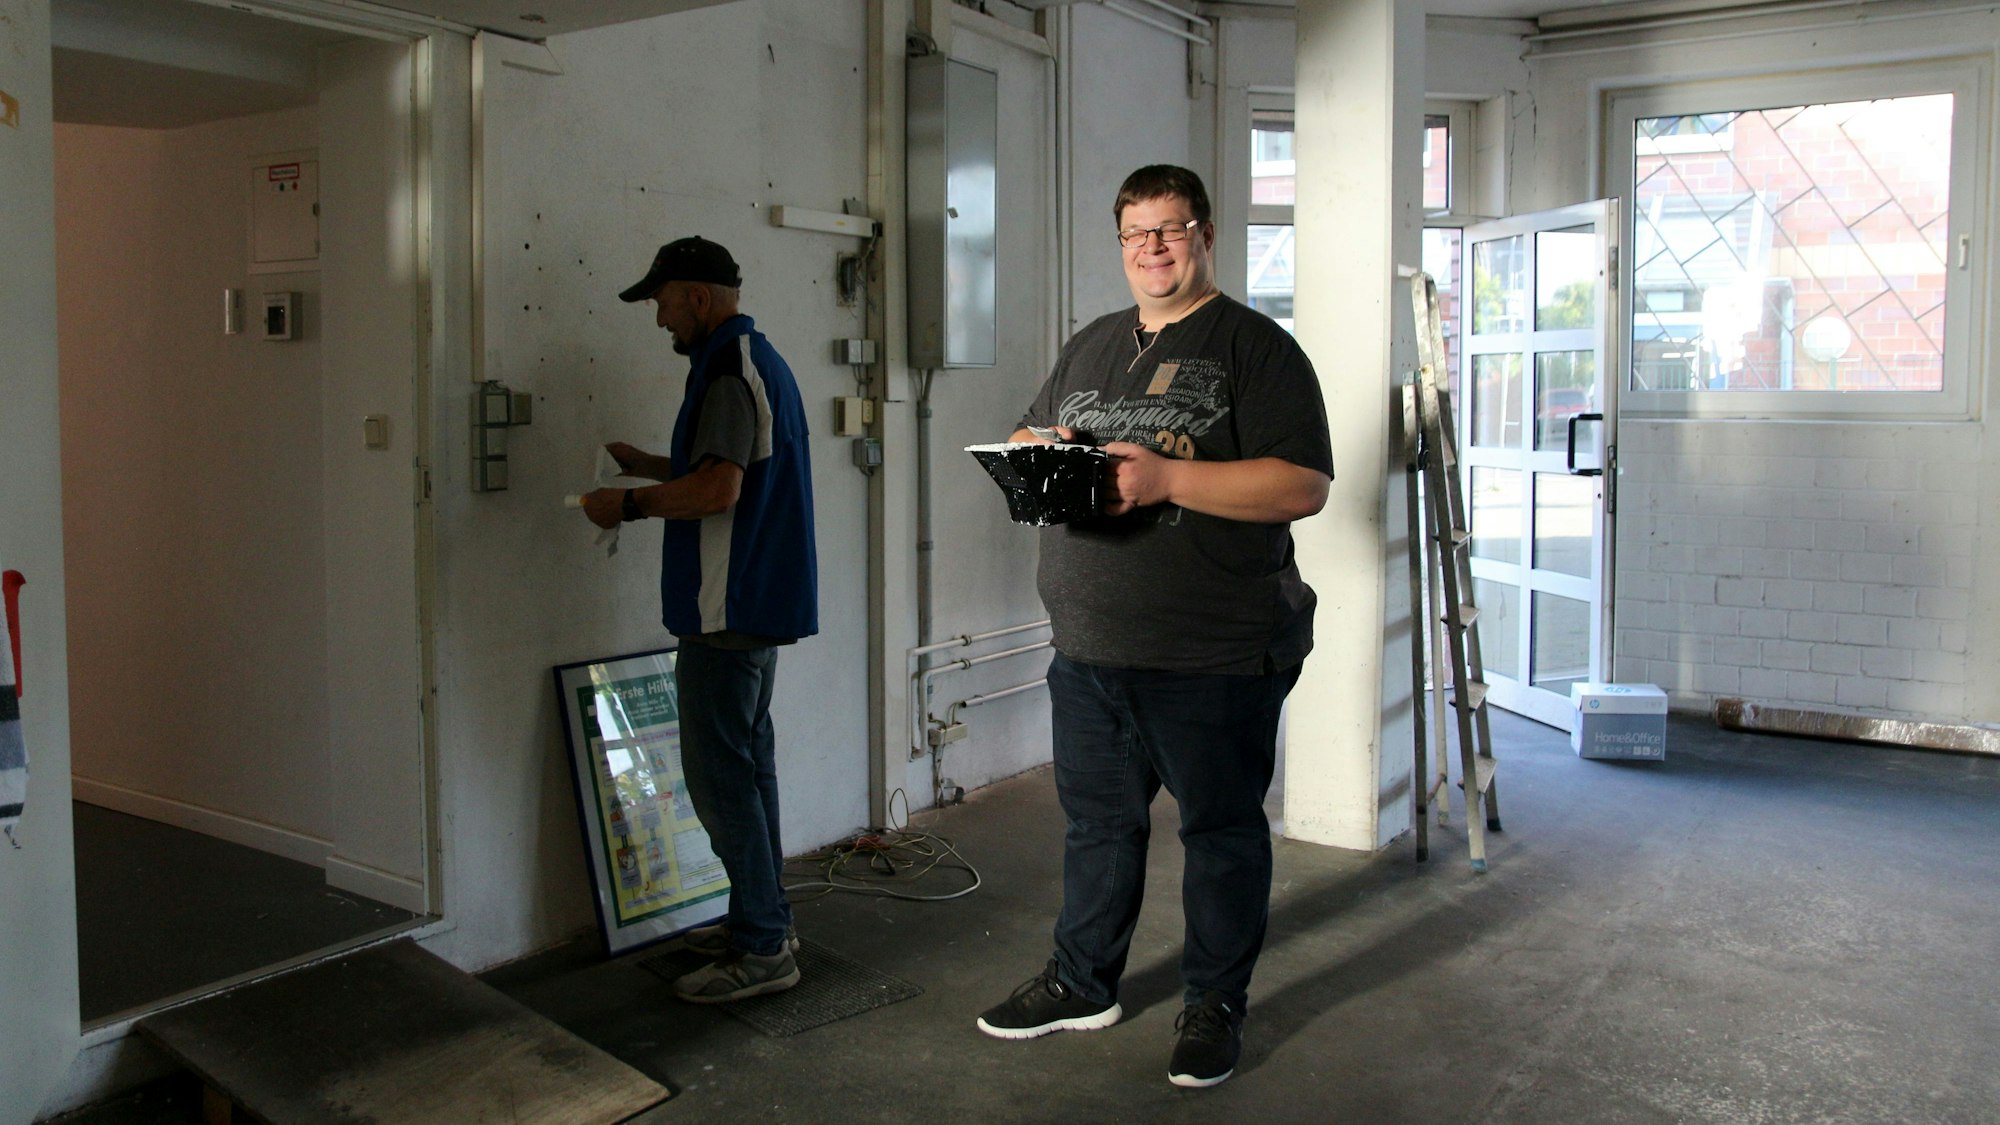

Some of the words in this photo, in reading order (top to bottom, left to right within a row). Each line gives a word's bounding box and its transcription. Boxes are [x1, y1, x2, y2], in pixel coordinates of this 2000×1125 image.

[1058, 389, 1230, 441] Centerguard
[647, 678, 675, 695] Hilfe
[1594, 731, 1661, 745] Home&Office
